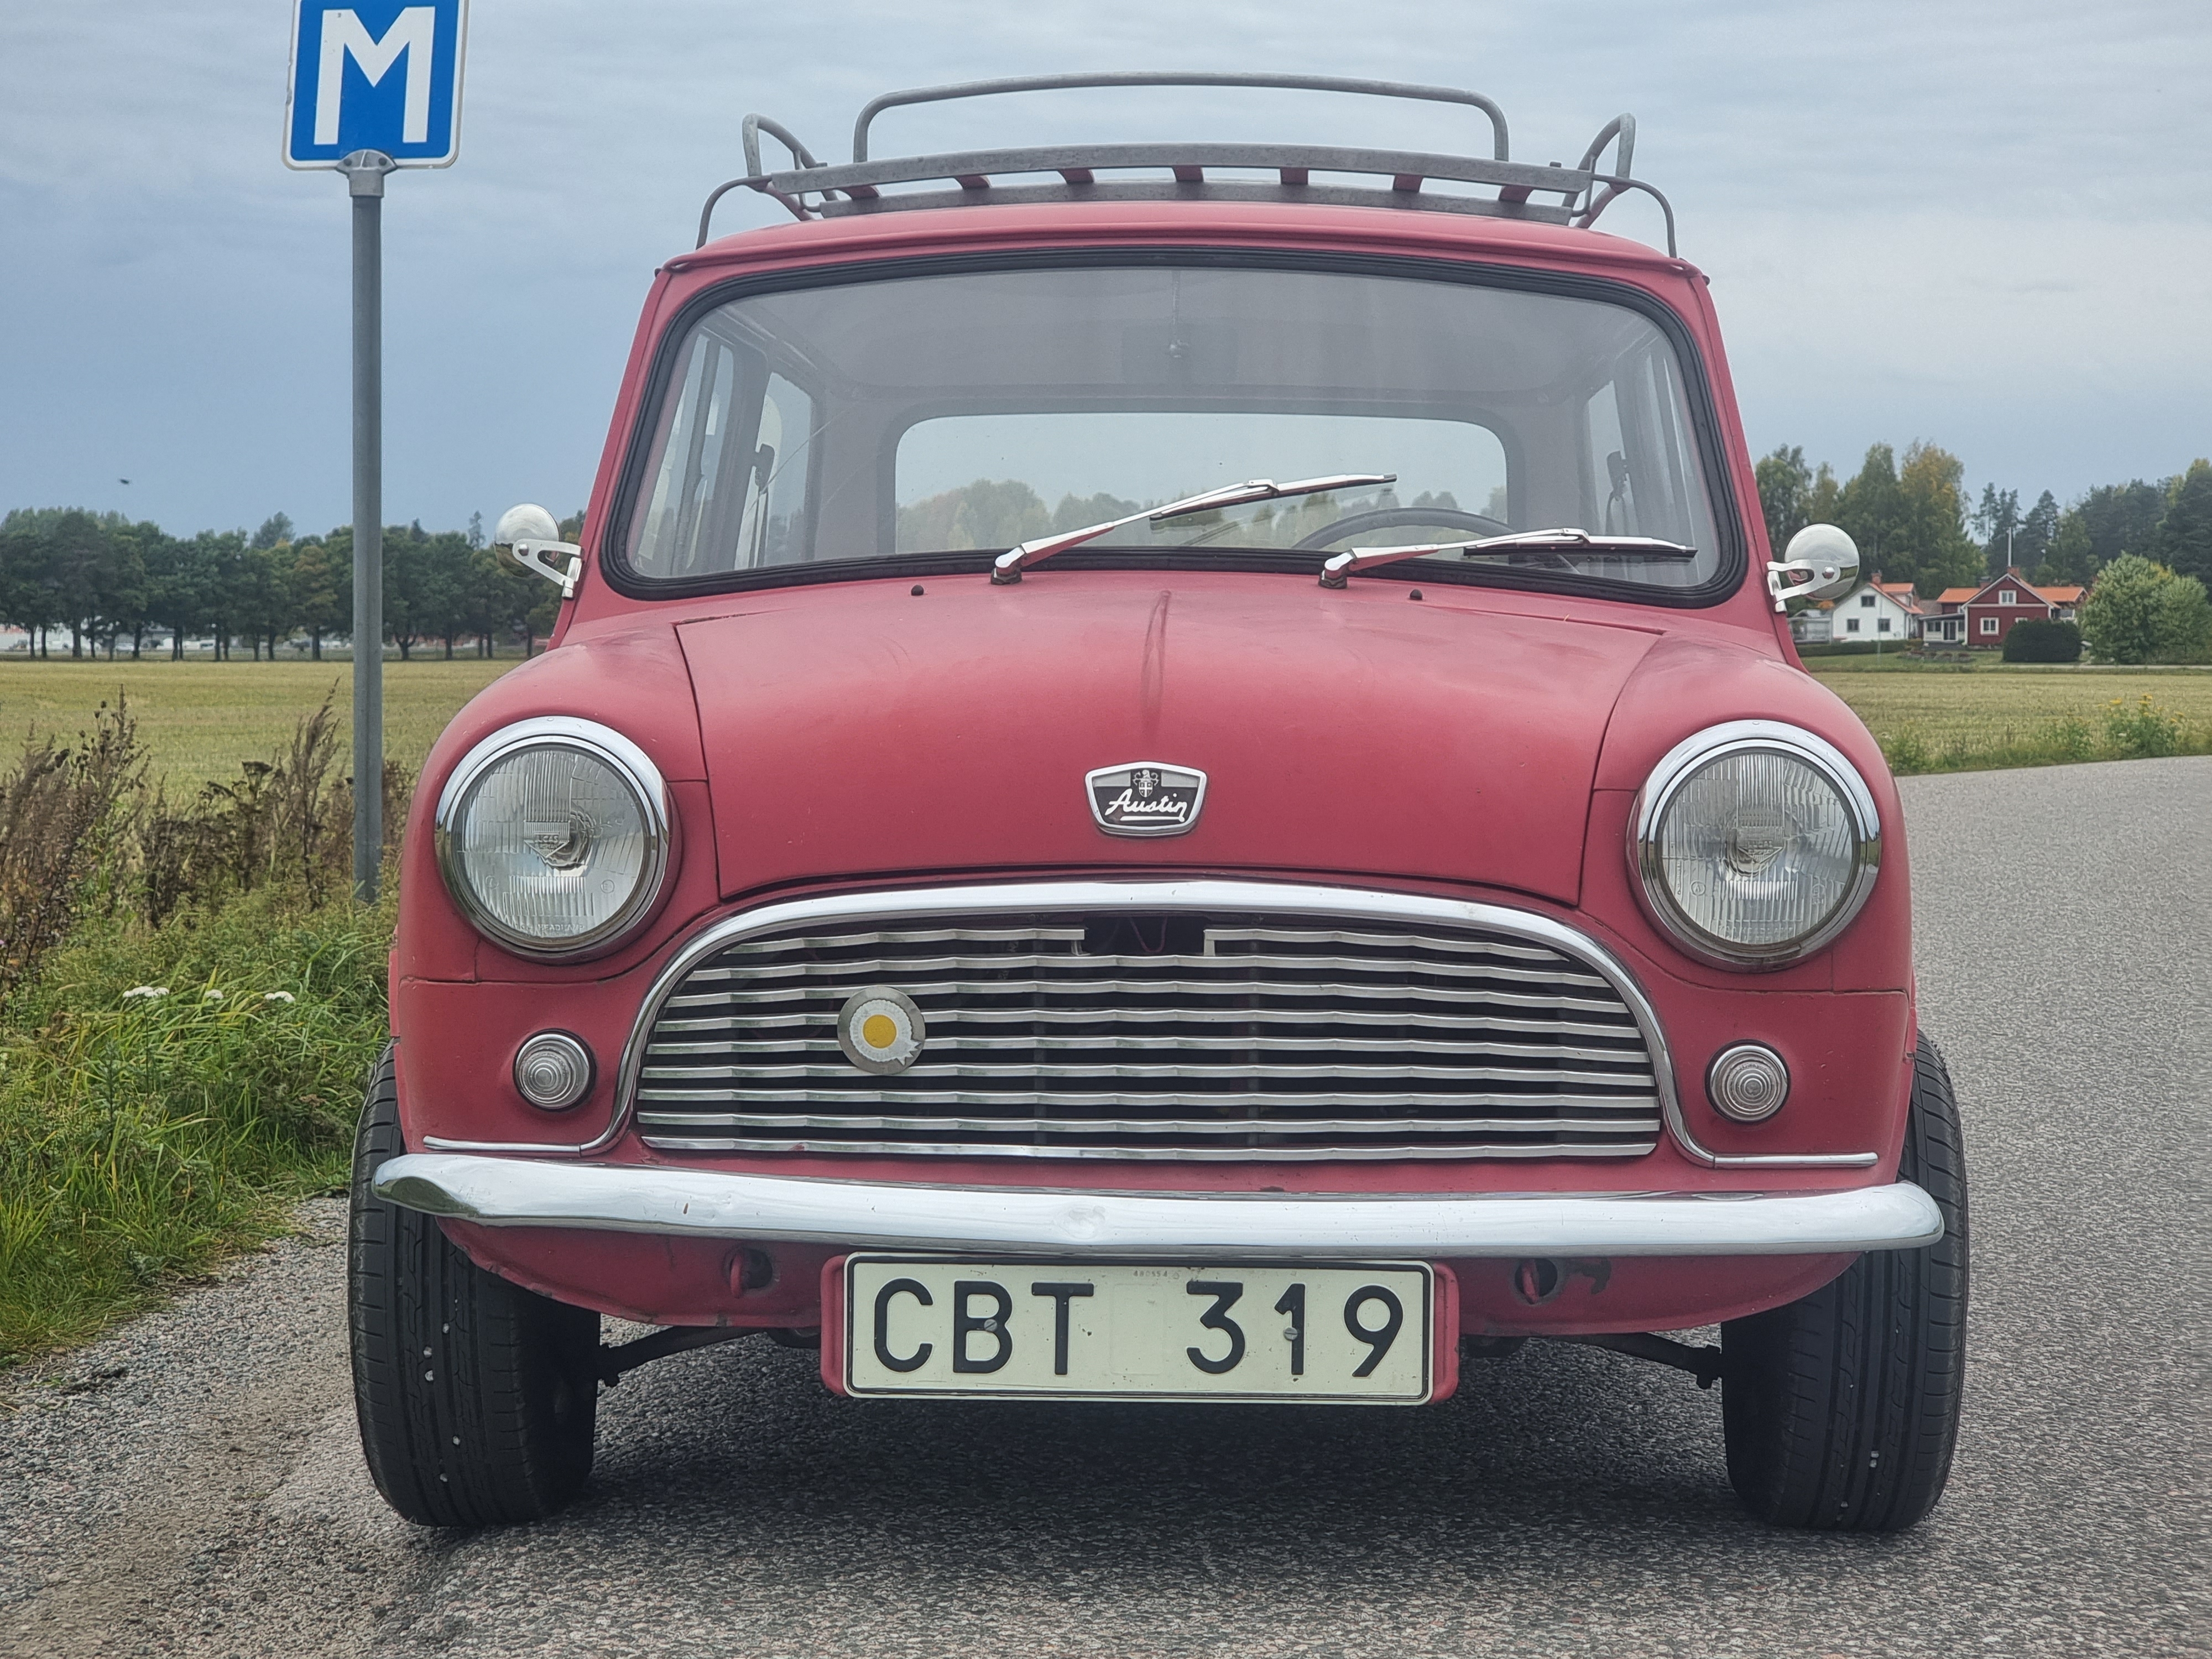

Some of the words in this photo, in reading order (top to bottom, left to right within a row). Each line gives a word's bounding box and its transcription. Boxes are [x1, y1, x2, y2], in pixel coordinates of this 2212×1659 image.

[314, 6, 436, 145] M
[1105, 788, 1188, 823] Austin
[873, 1278, 1094, 1375] CBT
[1185, 1281, 1404, 1378] 319
